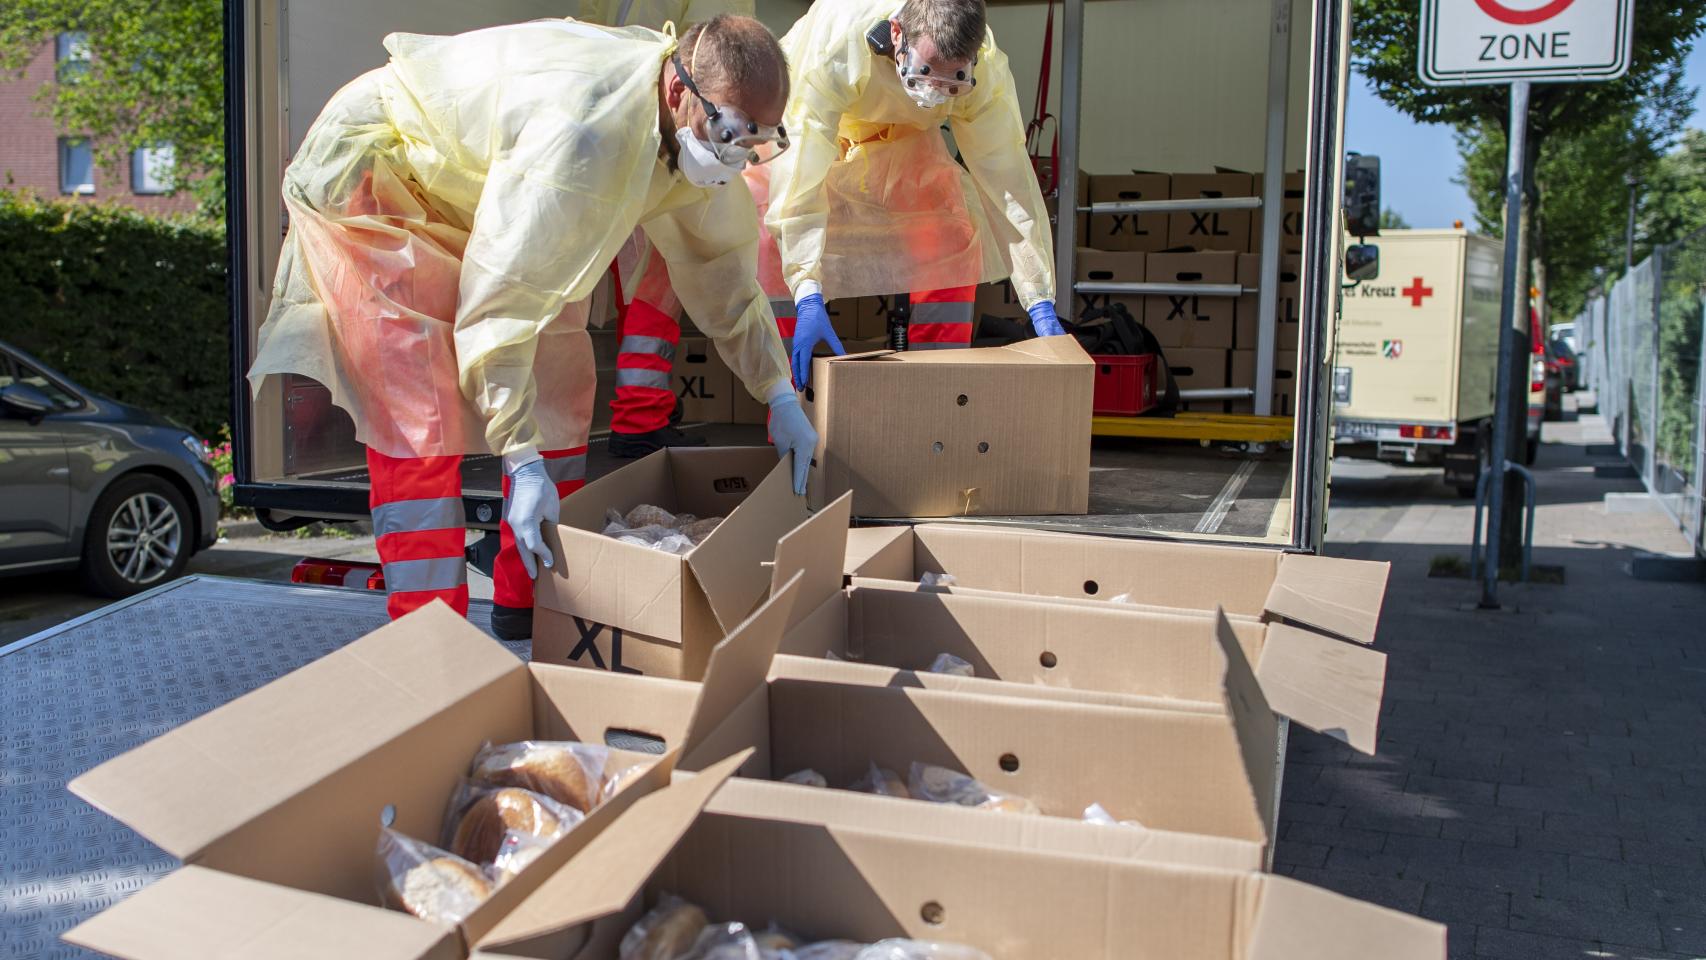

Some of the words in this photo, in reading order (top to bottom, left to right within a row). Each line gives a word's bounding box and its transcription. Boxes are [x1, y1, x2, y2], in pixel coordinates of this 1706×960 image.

[1478, 31, 1570, 61] ZONE
[1110, 213, 1148, 236] XL
[1189, 211, 1229, 236] XL
[1361, 284, 1396, 298] Kreuz
[1167, 295, 1210, 321] XL
[680, 376, 715, 399] XL
[567, 616, 643, 676] XL
